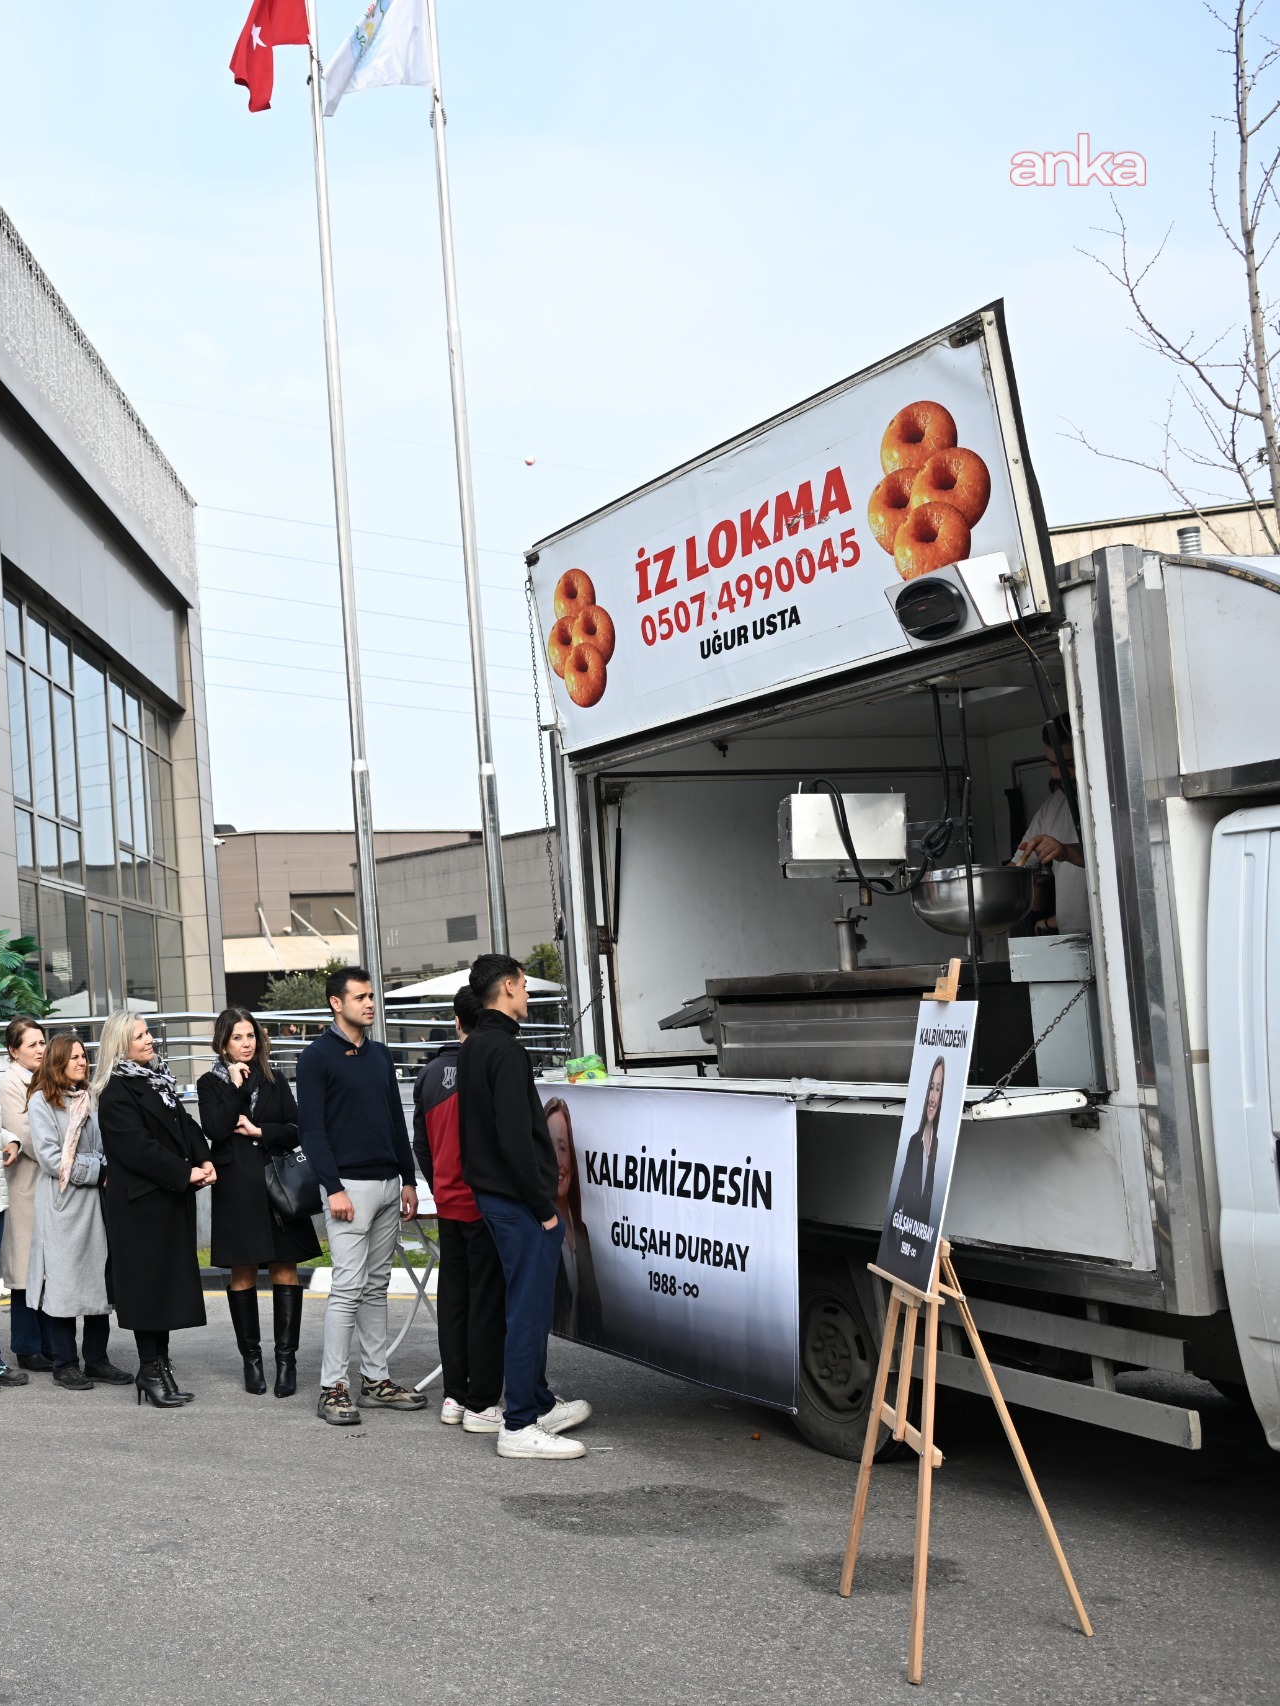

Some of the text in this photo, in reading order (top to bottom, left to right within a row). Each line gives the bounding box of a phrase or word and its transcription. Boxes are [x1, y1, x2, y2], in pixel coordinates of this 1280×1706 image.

[635, 465, 852, 604] İZ LOKMA
[641, 527, 861, 647] 0507.4990045
[699, 605, 801, 660] UĞUR USTA
[918, 1022, 968, 1049] KALBİMİZDESİN
[585, 1145, 772, 1210] KALBİMİZDESİN
[611, 1215, 750, 1272] GÜLŞAH DURBAY
[892, 1208, 934, 1243] GÜLŞAH DURBAY
